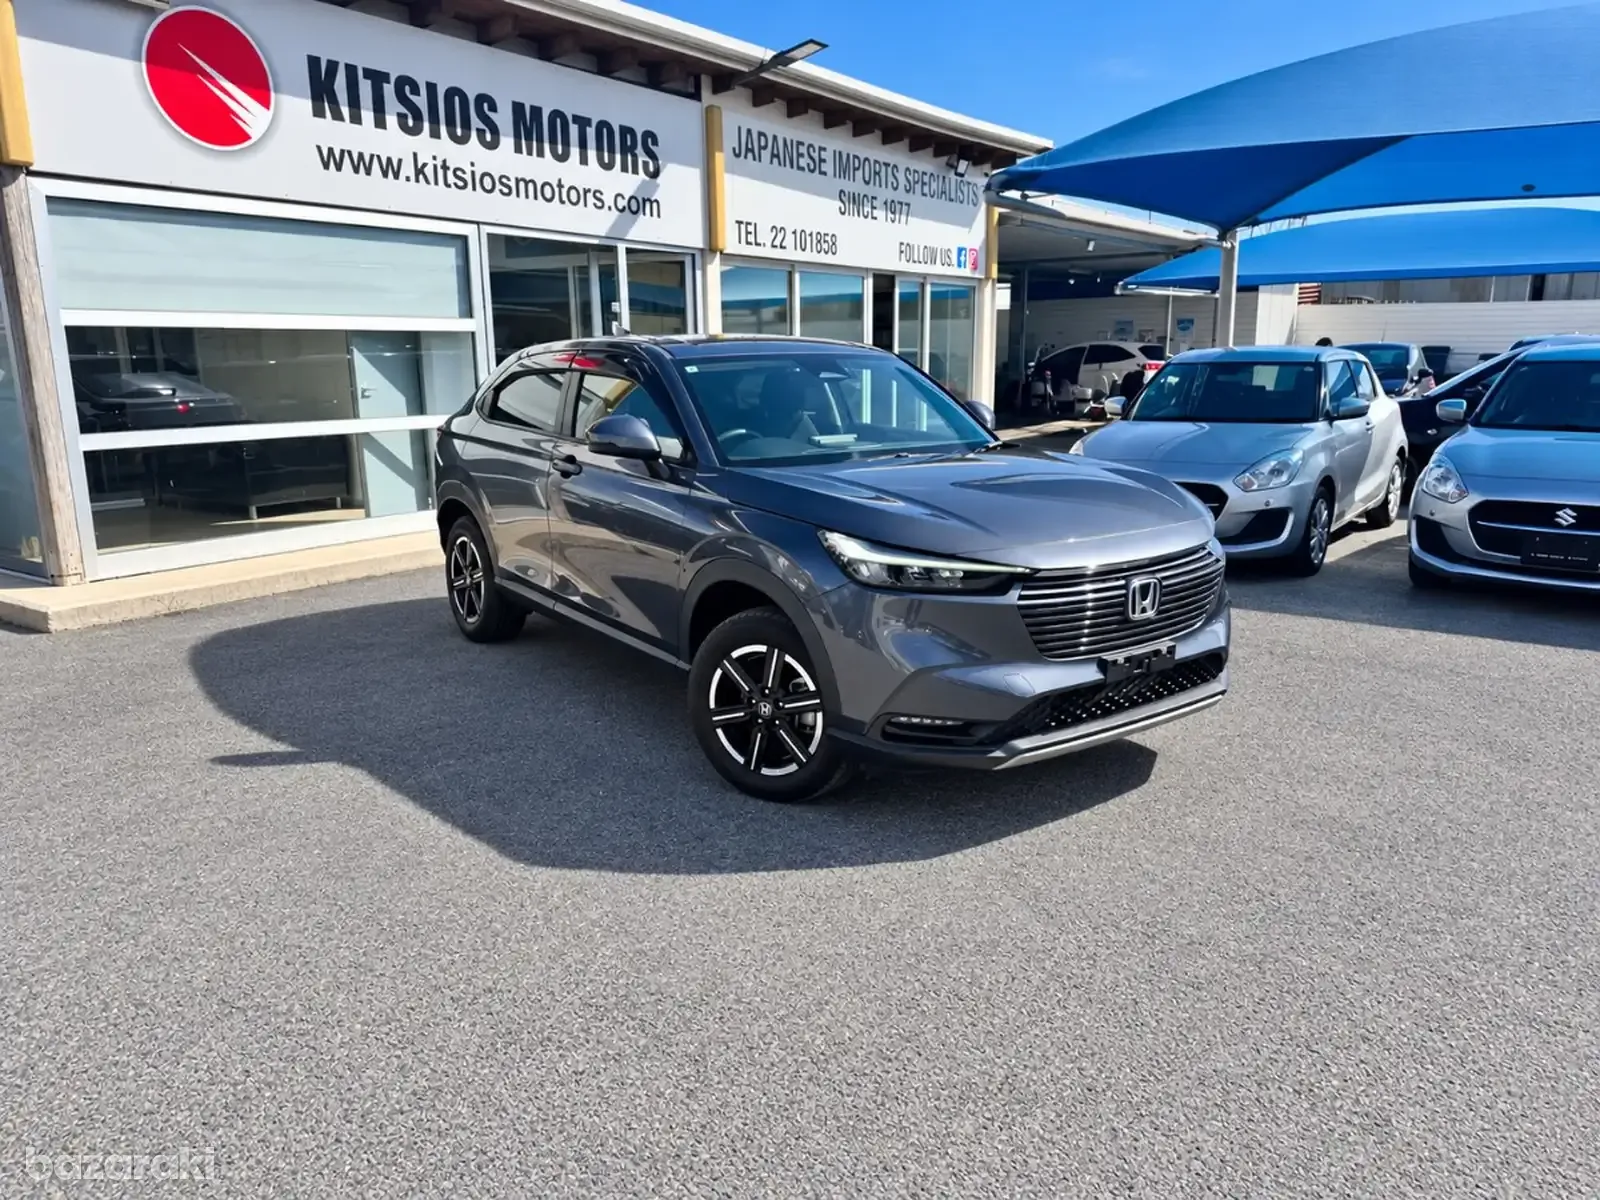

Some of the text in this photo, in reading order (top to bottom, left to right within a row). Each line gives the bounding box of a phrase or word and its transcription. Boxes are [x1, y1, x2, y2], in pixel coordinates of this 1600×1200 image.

[306, 54, 661, 179] KITSIOS MOTORS
[316, 143, 661, 219] www.kitsiosmotors.com
[732, 125, 979, 208] JAPANESE IMPORTS SPECIALISTS
[838, 189, 911, 226] SINCE 1977
[735, 220, 838, 256] TEL. 22 101858
[899, 241, 938, 266] FOLLOW
